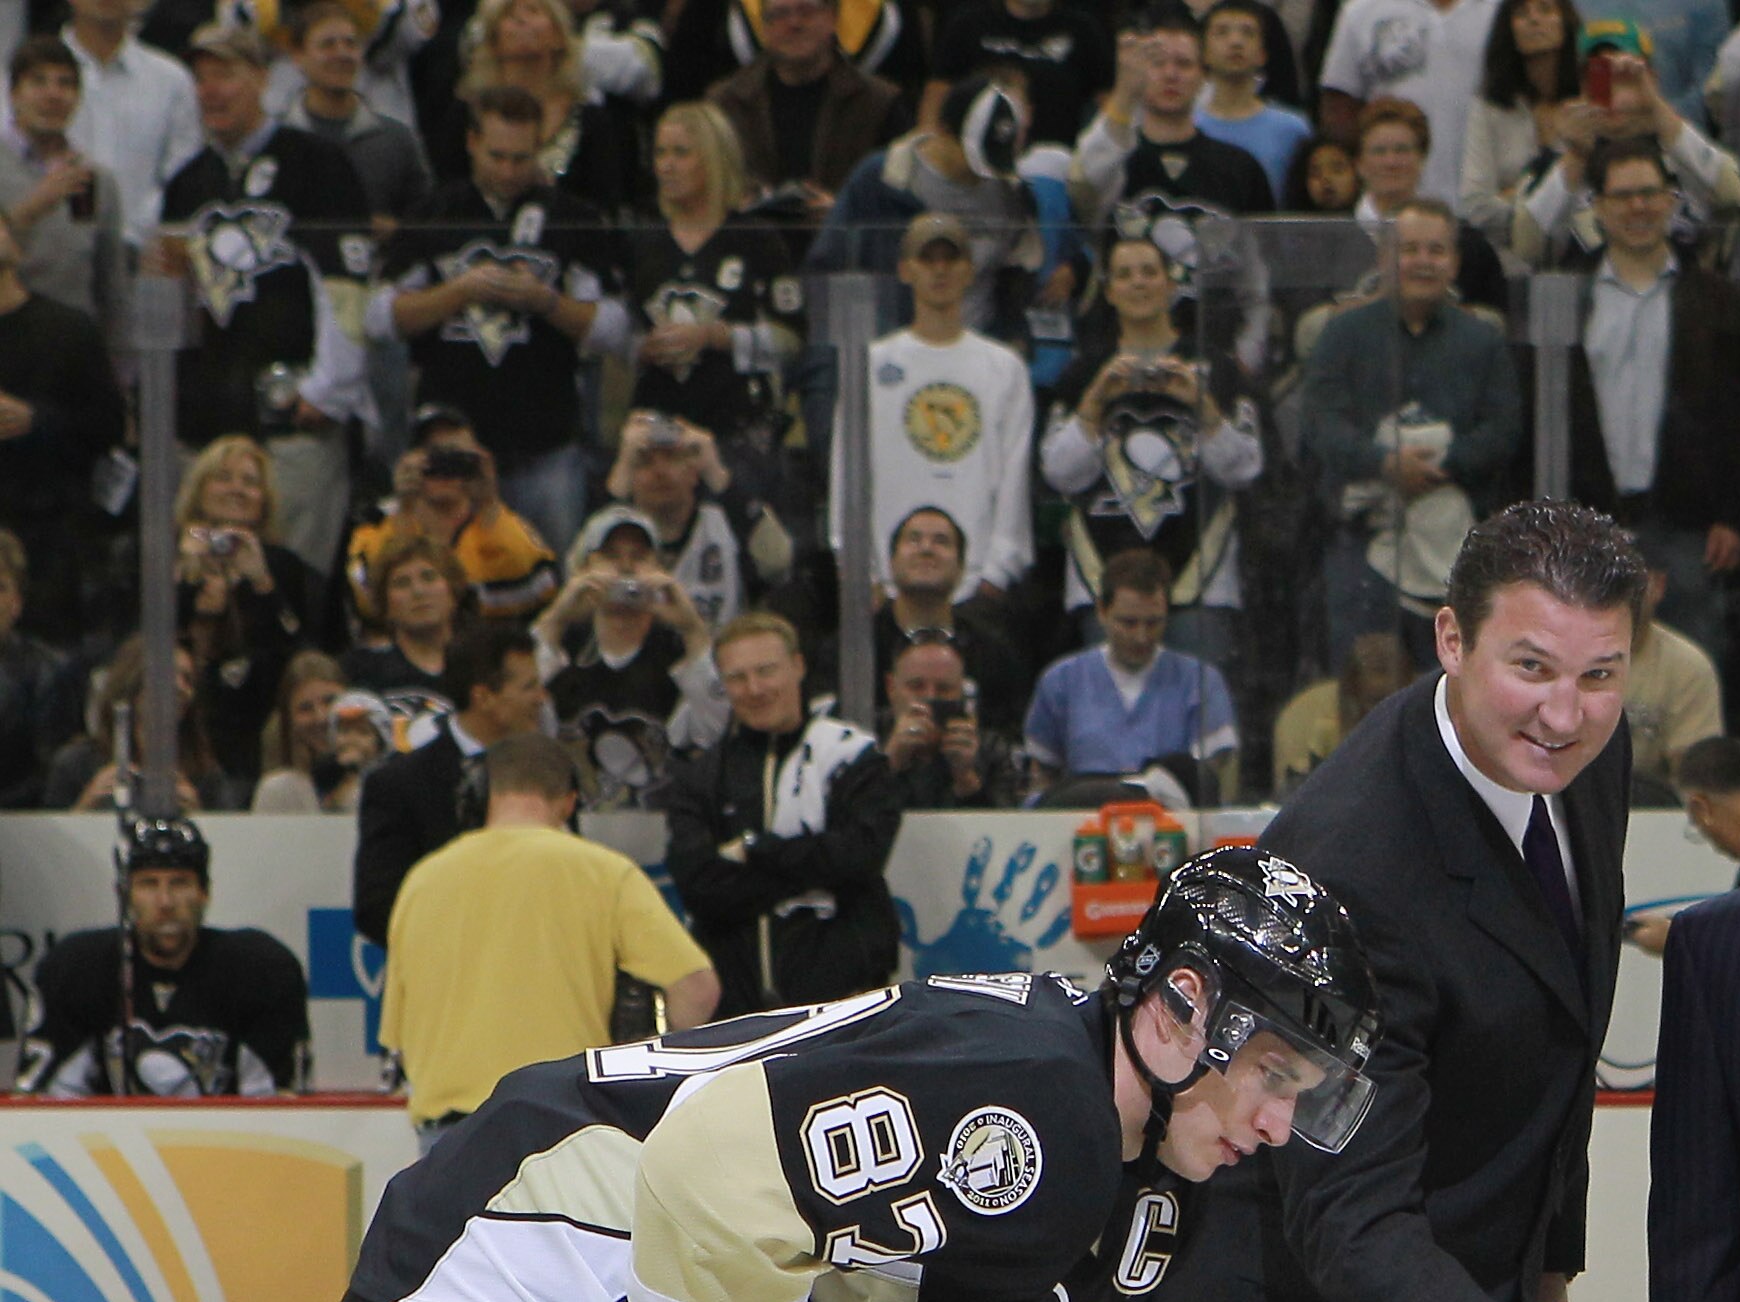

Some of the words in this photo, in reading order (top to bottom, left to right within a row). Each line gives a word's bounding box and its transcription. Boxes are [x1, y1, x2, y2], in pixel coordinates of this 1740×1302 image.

[985, 1114, 1036, 1164] INAUGURAL
[999, 1165, 1036, 1207] SEASON
[1111, 1186, 1180, 1296] C
